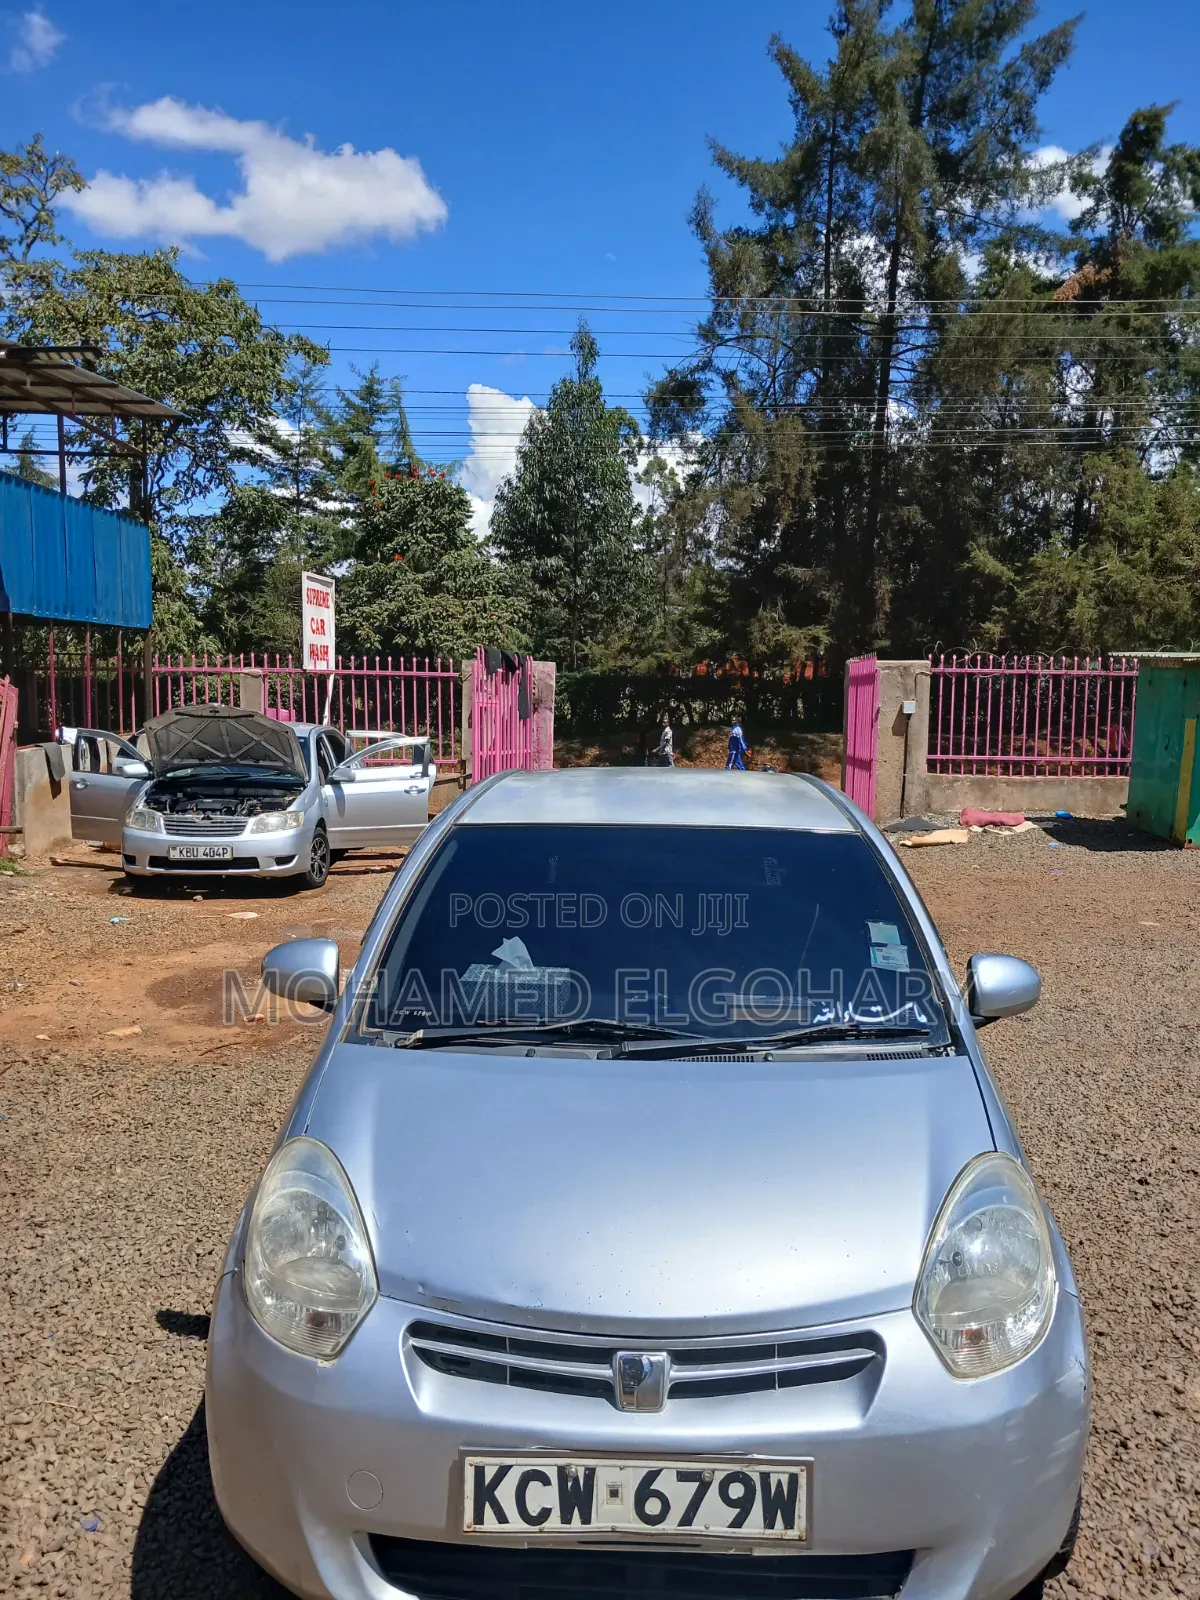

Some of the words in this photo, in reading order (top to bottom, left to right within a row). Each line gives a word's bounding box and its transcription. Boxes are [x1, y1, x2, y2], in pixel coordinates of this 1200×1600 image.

[306, 587, 330, 609] SUPREME
[310, 617, 326, 636] CAR
[309, 643, 330, 662] WASH
[178, 847, 199, 858] KBU
[202, 847, 229, 858] 404P
[473, 1465, 596, 1526] KCW
[634, 1468, 798, 1530] 679W
